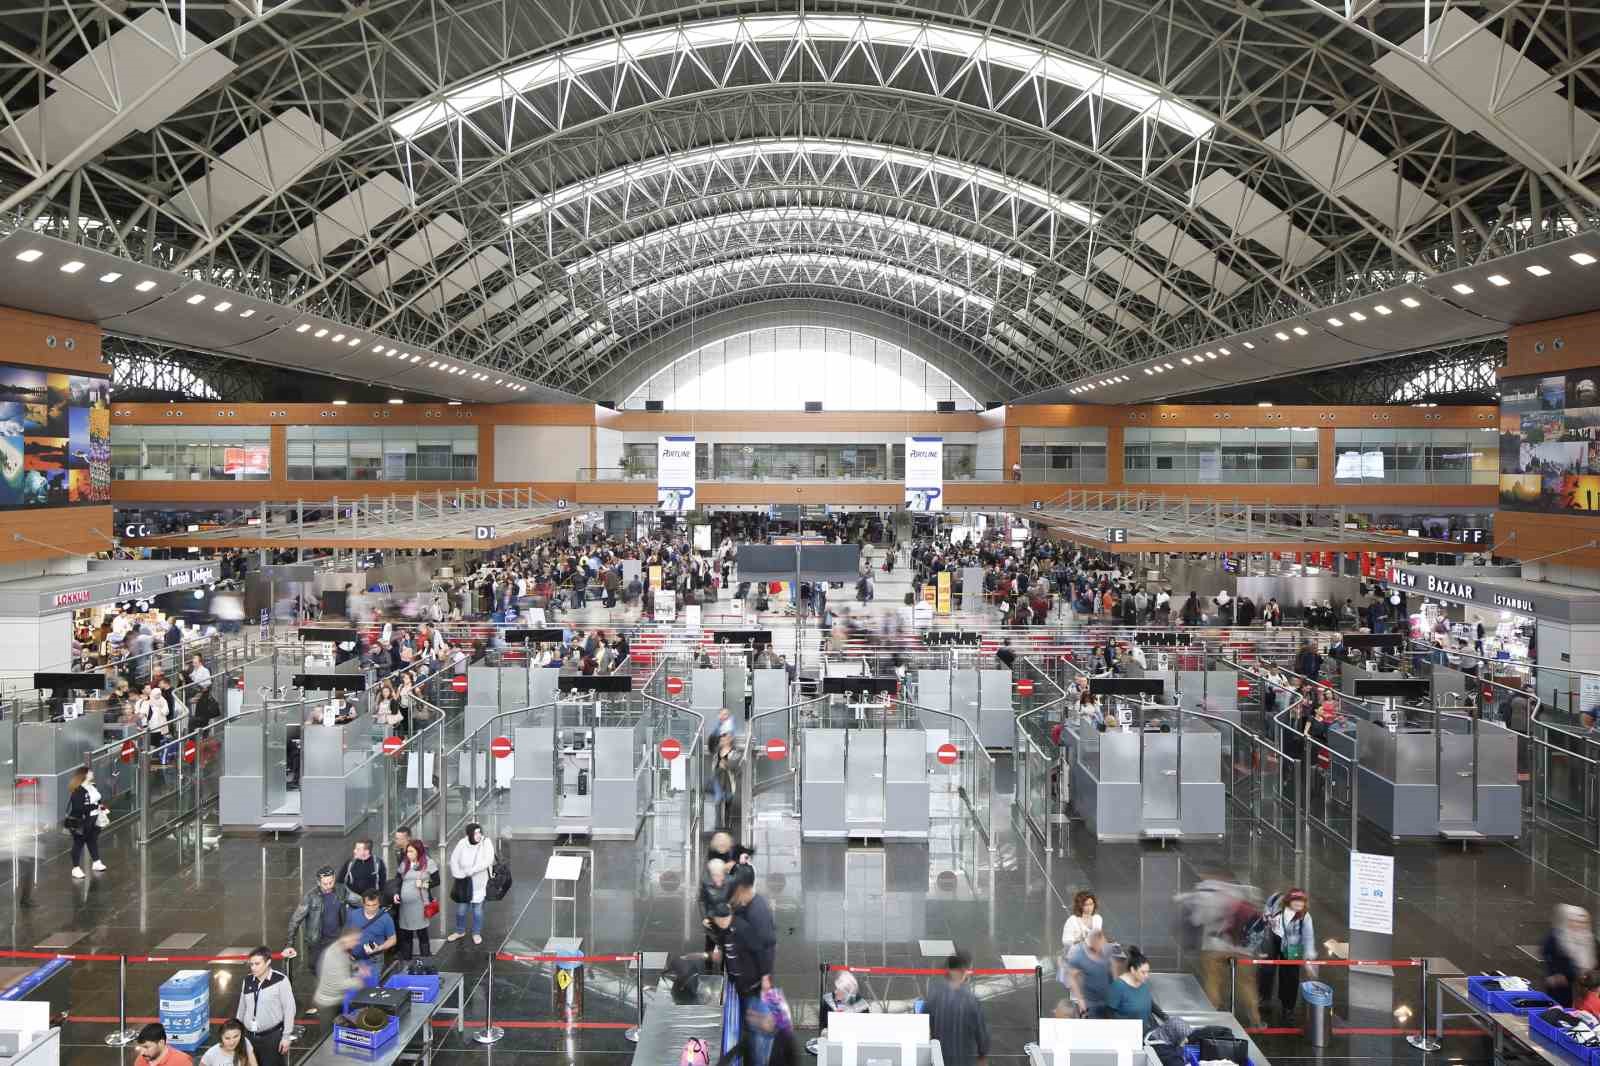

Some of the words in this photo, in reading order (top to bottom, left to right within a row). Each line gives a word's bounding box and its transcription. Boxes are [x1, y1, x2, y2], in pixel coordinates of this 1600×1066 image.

[477, 527, 488, 539] D
[1115, 530, 1123, 541] E
[167, 571, 190, 587] Turkish
[191, 568, 213, 583] Delight
